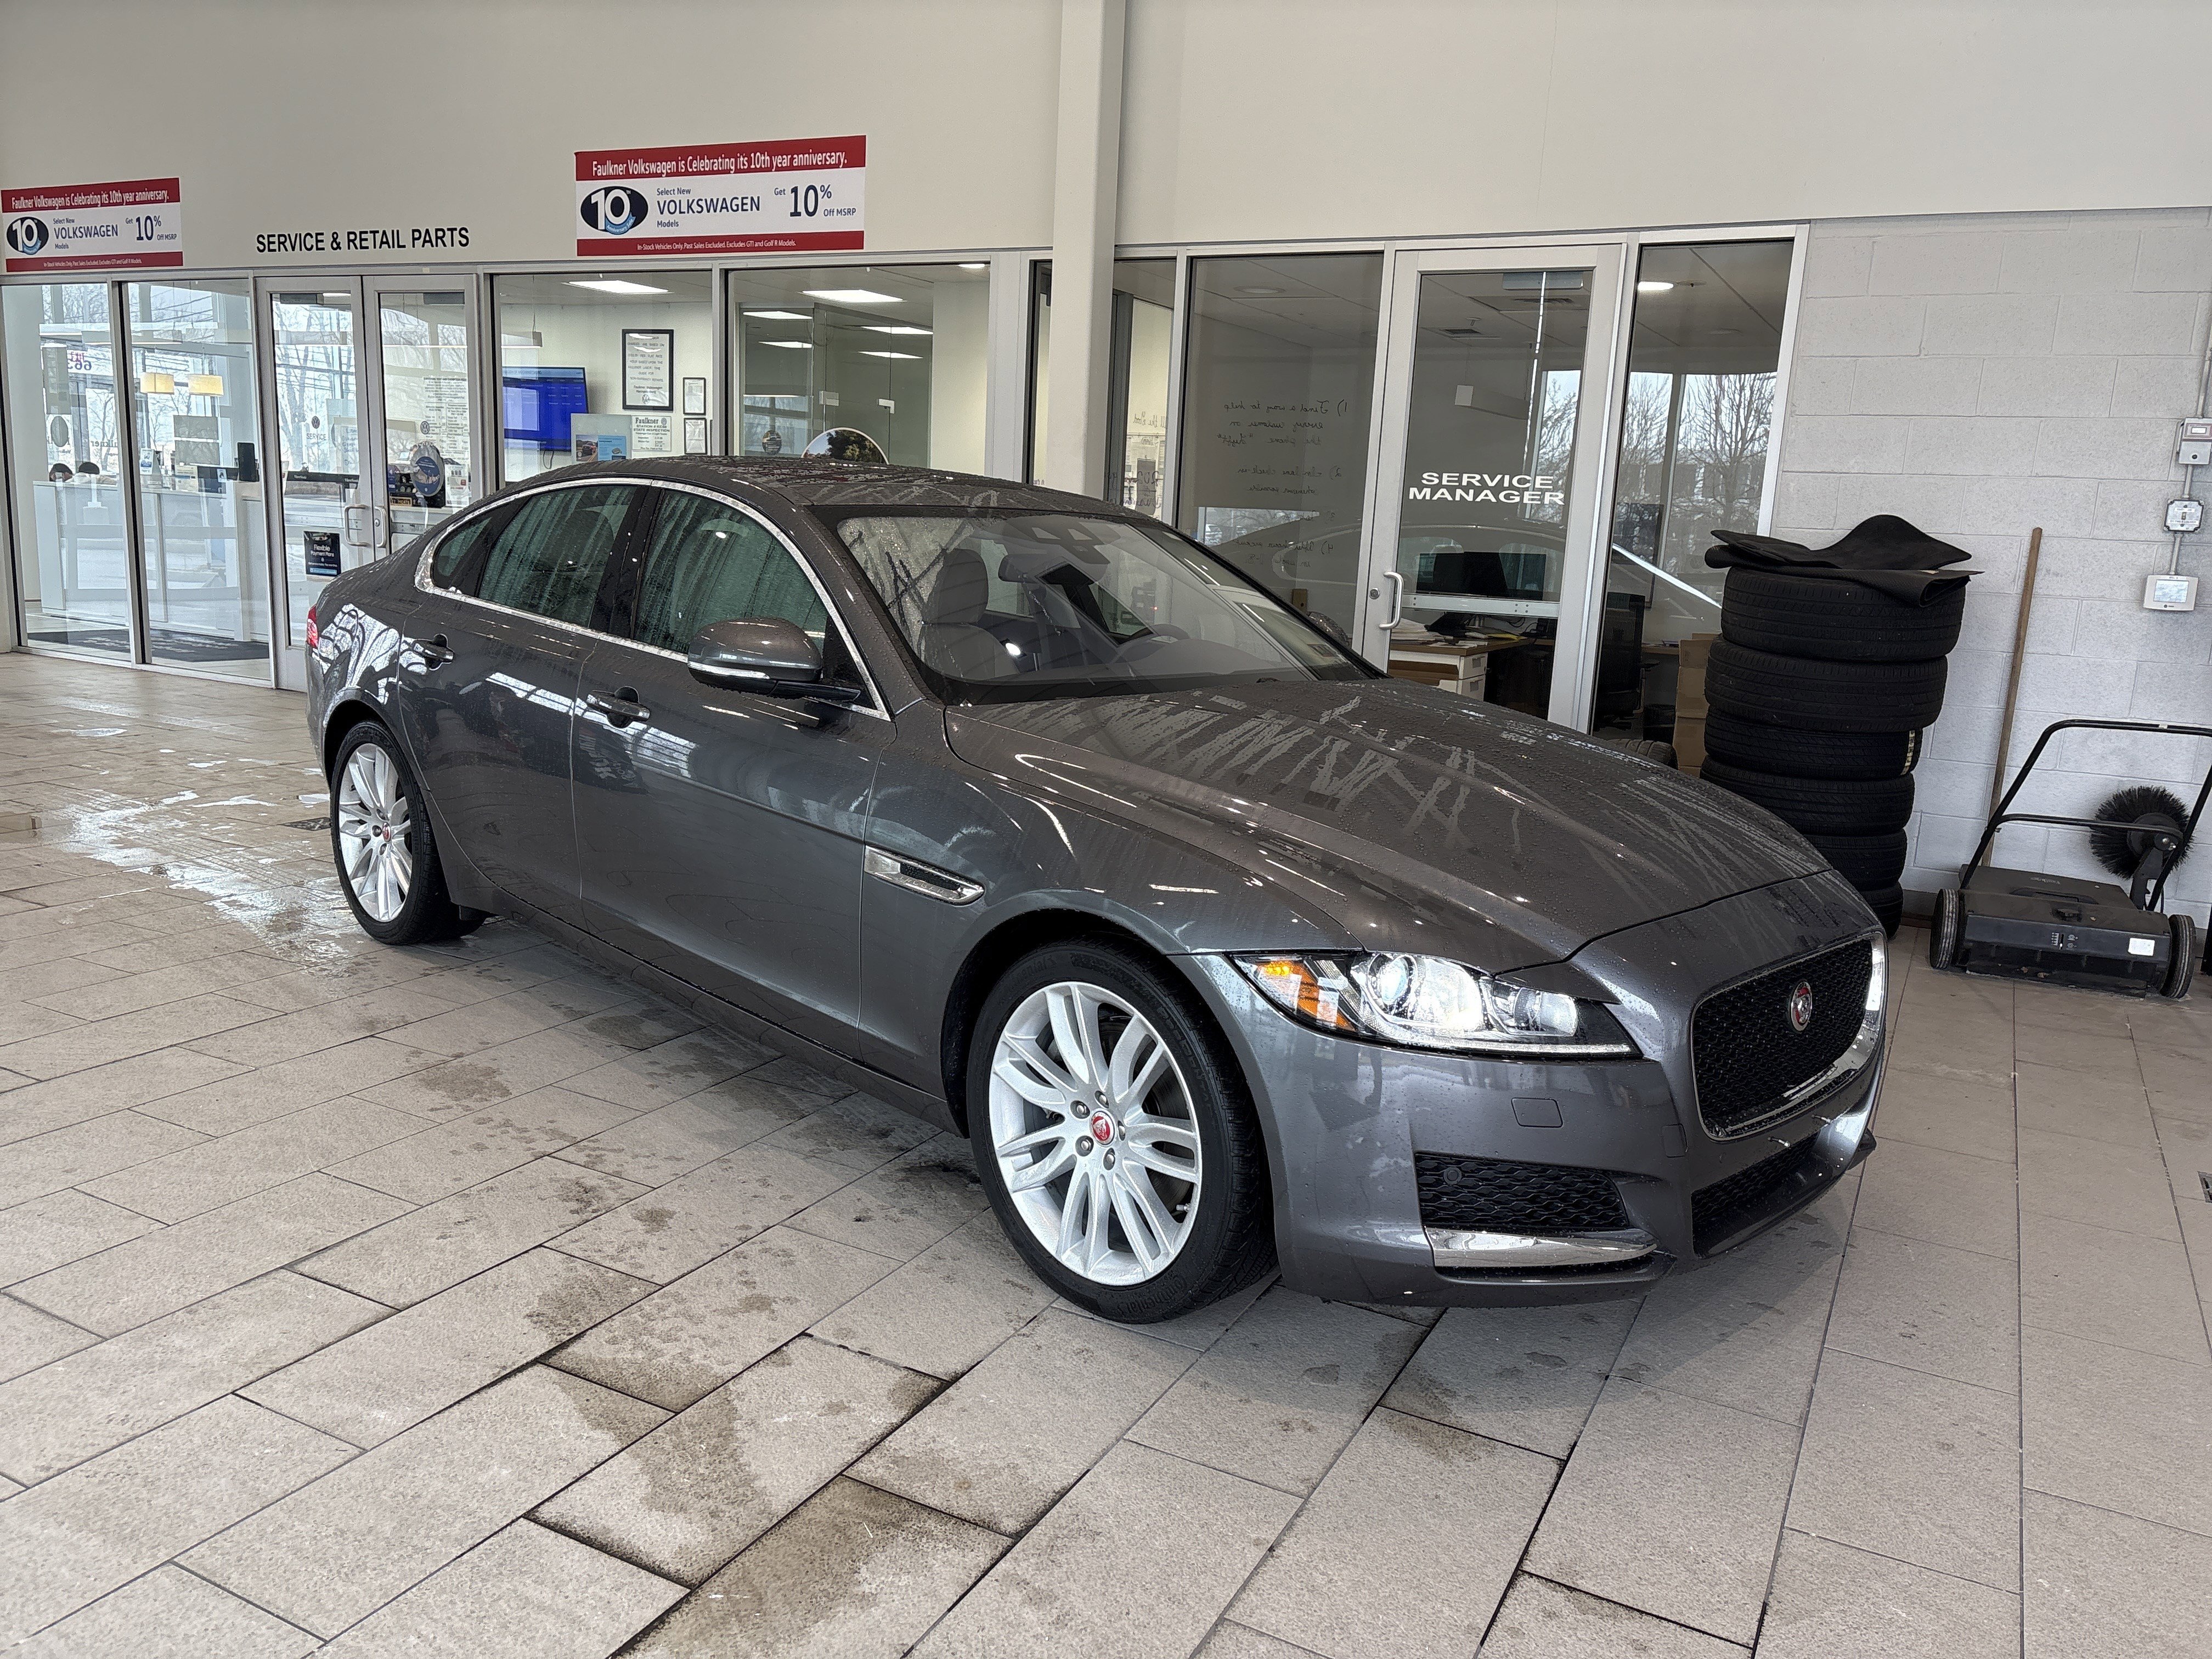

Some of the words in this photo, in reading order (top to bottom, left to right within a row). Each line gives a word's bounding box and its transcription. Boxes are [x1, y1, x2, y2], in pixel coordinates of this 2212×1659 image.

[592, 160, 627, 176] Faulkner
[628, 158, 676, 177] Volkswagen
[678, 156, 685, 172] is
[687, 154, 735, 173] Celebrating
[737, 153, 748, 169] it's
[750, 151, 770, 168] 10th
[771, 154, 792, 172] year
[793, 149, 848, 168] anniversary.
[12, 196, 33, 210] Faulkner
[33, 195, 65, 210] Volkswagen
[65, 194, 70, 205] is
[71, 192, 101, 207] Celebrating
[109, 190, 122, 203] 10th
[122, 192, 134, 205] year
[136, 188, 169, 202] anniversary.
[657, 188, 675, 196] Select
[774, 187, 786, 196] Get
[657, 196, 760, 215] VOLKSWAGEN
[823, 208, 834, 217] Off
[836, 207, 856, 216] MSRP
[54, 224, 118, 240] VOLKSWAGEN
[657, 219, 679, 228] Models
[256, 232, 325, 253] SERVICE
[330, 231, 341, 251] &
[347, 229, 406, 250] RETAIL
[411, 227, 470, 249] PARTS
[1421, 472, 1554, 489] SERVICE
[1409, 487, 1565, 505] MANAGER
